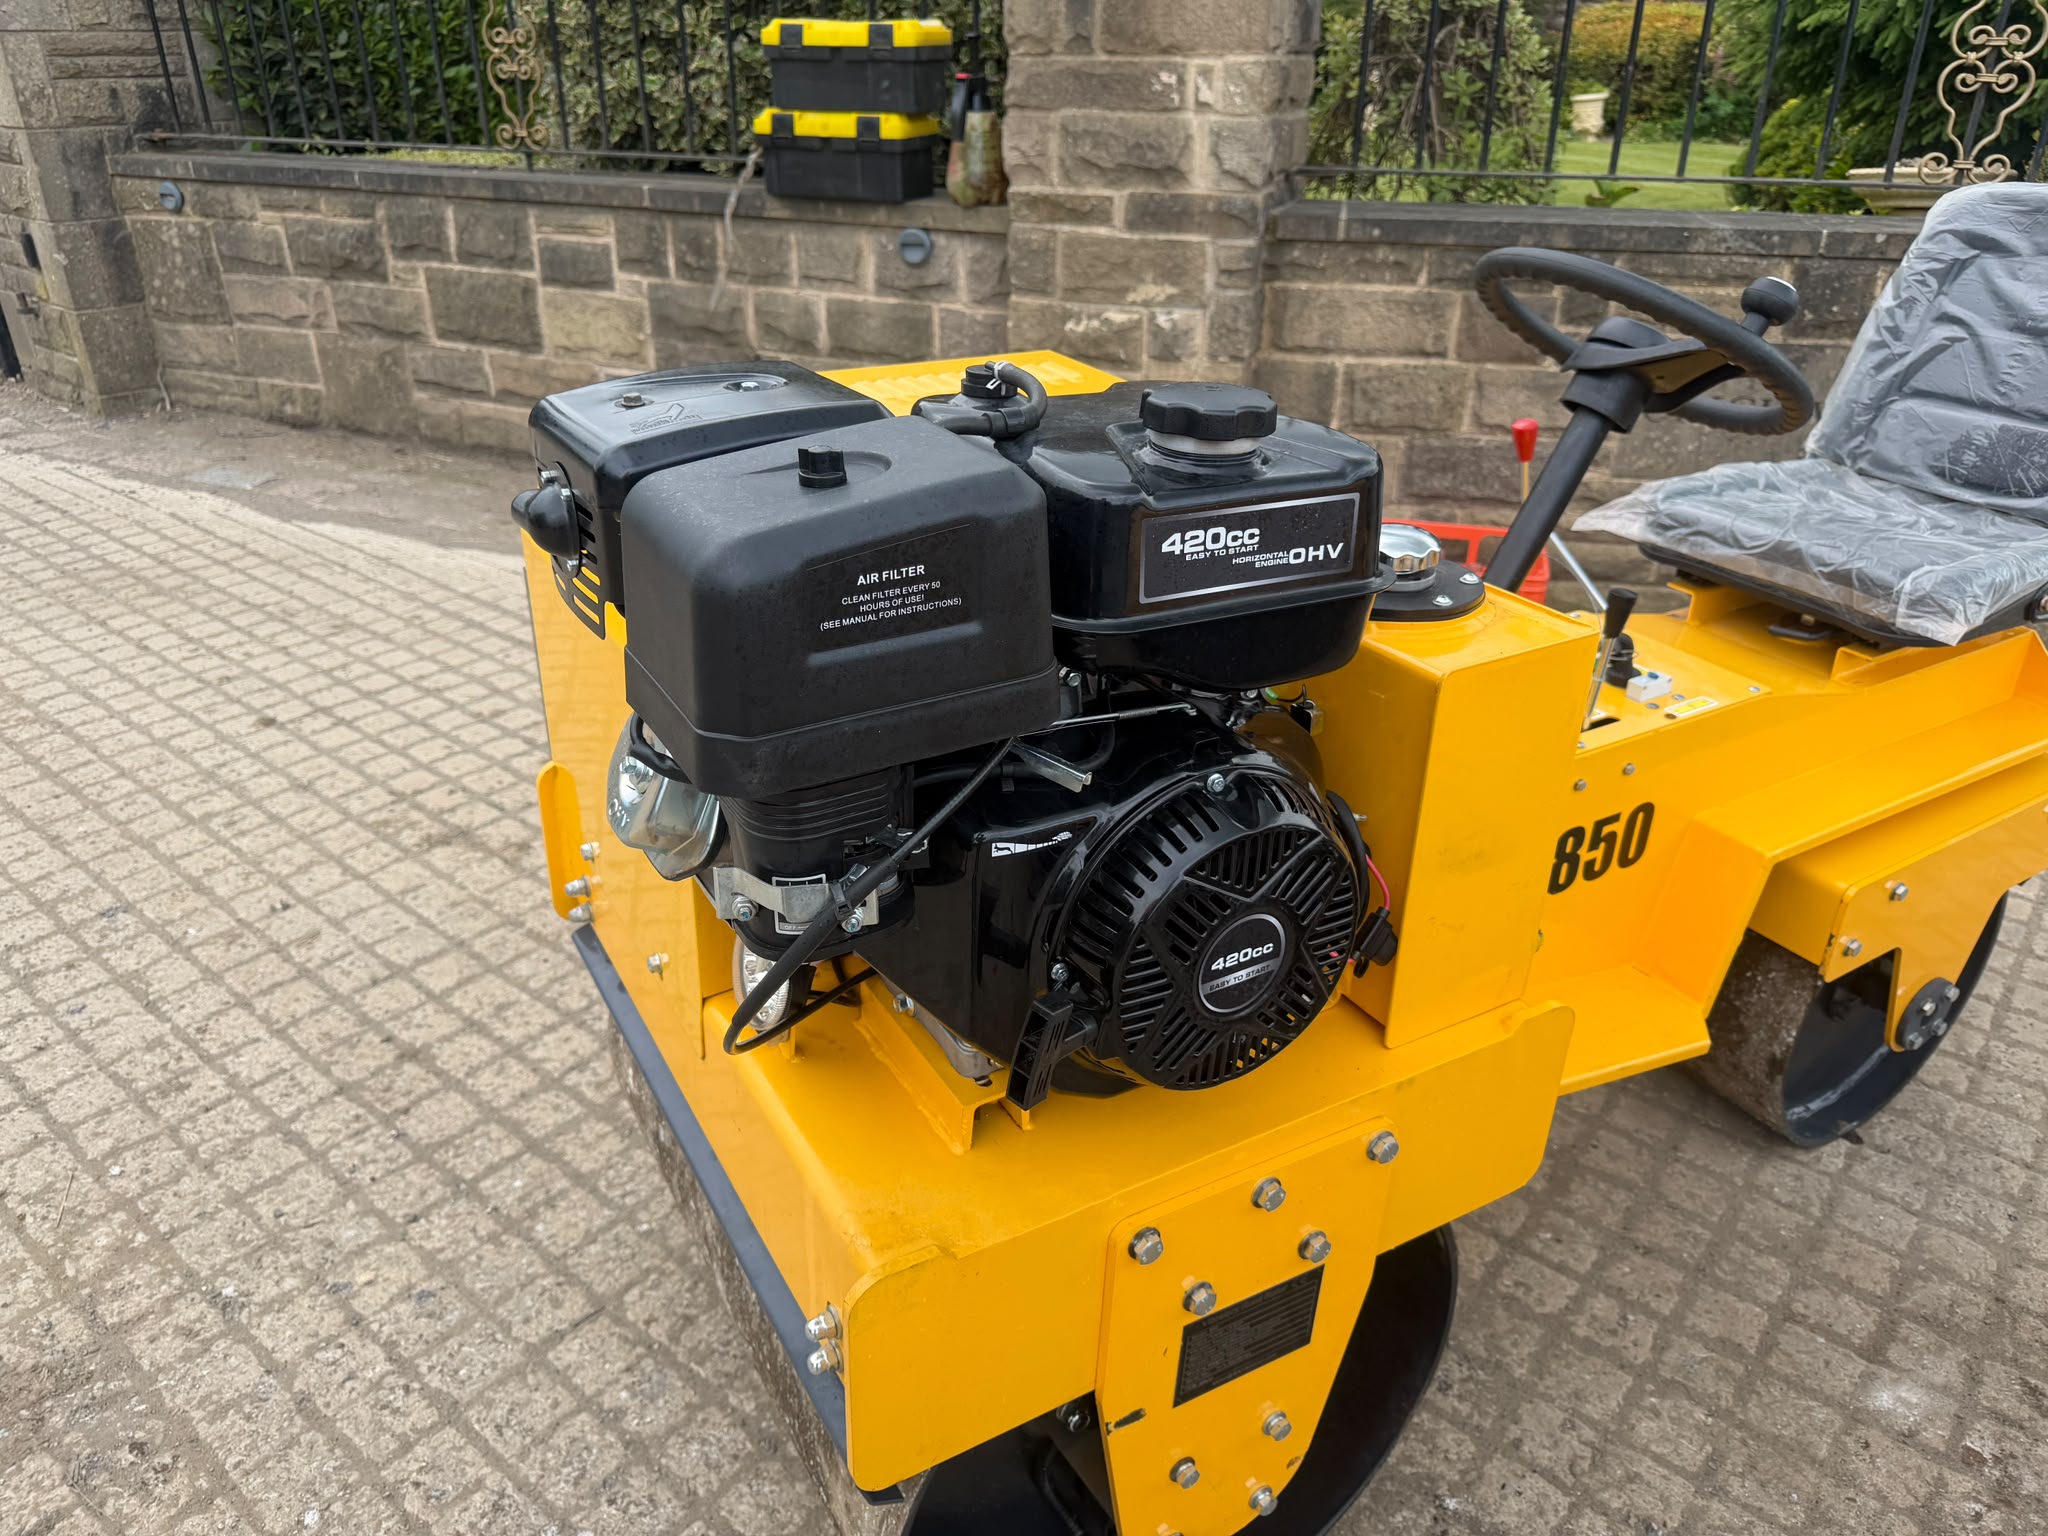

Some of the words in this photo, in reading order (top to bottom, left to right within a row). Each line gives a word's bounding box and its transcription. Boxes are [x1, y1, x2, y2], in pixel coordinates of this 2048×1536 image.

[1161, 526, 1260, 555] 420cc
[1185, 551, 1211, 561] EASY
[1213, 548, 1226, 557] TO
[1228, 544, 1259, 555] START
[1232, 551, 1289, 565] HORIZONTAL
[1255, 557, 1289, 568] ENGINE
[1288, 542, 1344, 565] OHV
[857, 572, 879, 586] AIR
[882, 565, 925, 581] FILTER
[841, 593, 871, 605] CLEAN
[872, 589, 901, 599] FILTER
[902, 583, 930, 595] EVERY
[931, 580, 941, 589] 50
[860, 601, 891, 613] HOURS
[891, 599, 903, 607] OF
[905, 594, 925, 604] USE!
[820, 619, 841, 632] (SEE
[842, 613, 878, 626] MANUAL
[879, 609, 897, 620] FOR
[898, 597, 962, 616] INSTRUCTIONS)
[1547, 801, 1655, 896] 850
[1211, 943, 1273, 970] 420cc
[1209, 980, 1230, 991] EASY
[1245, 965, 1270, 977] START
